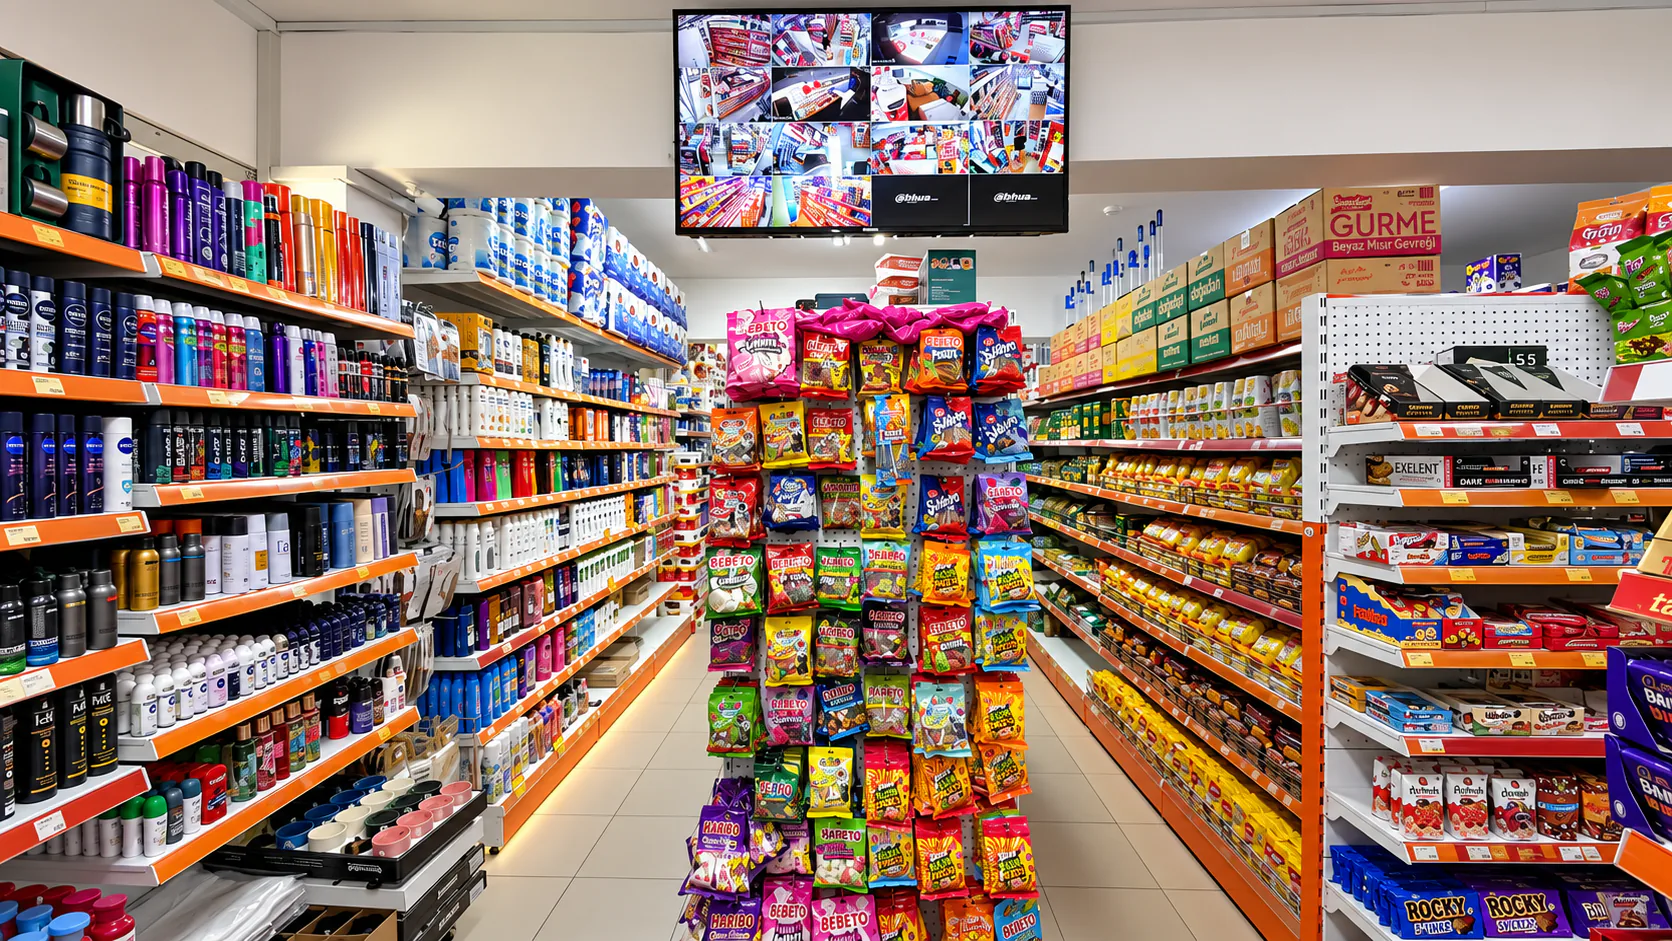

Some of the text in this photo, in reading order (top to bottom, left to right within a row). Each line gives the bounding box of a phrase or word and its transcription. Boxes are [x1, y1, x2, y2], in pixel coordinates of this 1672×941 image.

[1330, 210, 1436, 238] GURME
[1332, 241, 1365, 254] Beyaz
[1395, 462, 1439, 475] EXELENT
[710, 555, 754, 569] BEBETO
[703, 820, 740, 836] HARIBO
[769, 903, 807, 919] BEBETO
[1404, 895, 1466, 923] ROCKY
[1483, 892, 1548, 919] ROCKY
[711, 913, 754, 929] HARIBO
[820, 911, 868, 932] BEBETO
